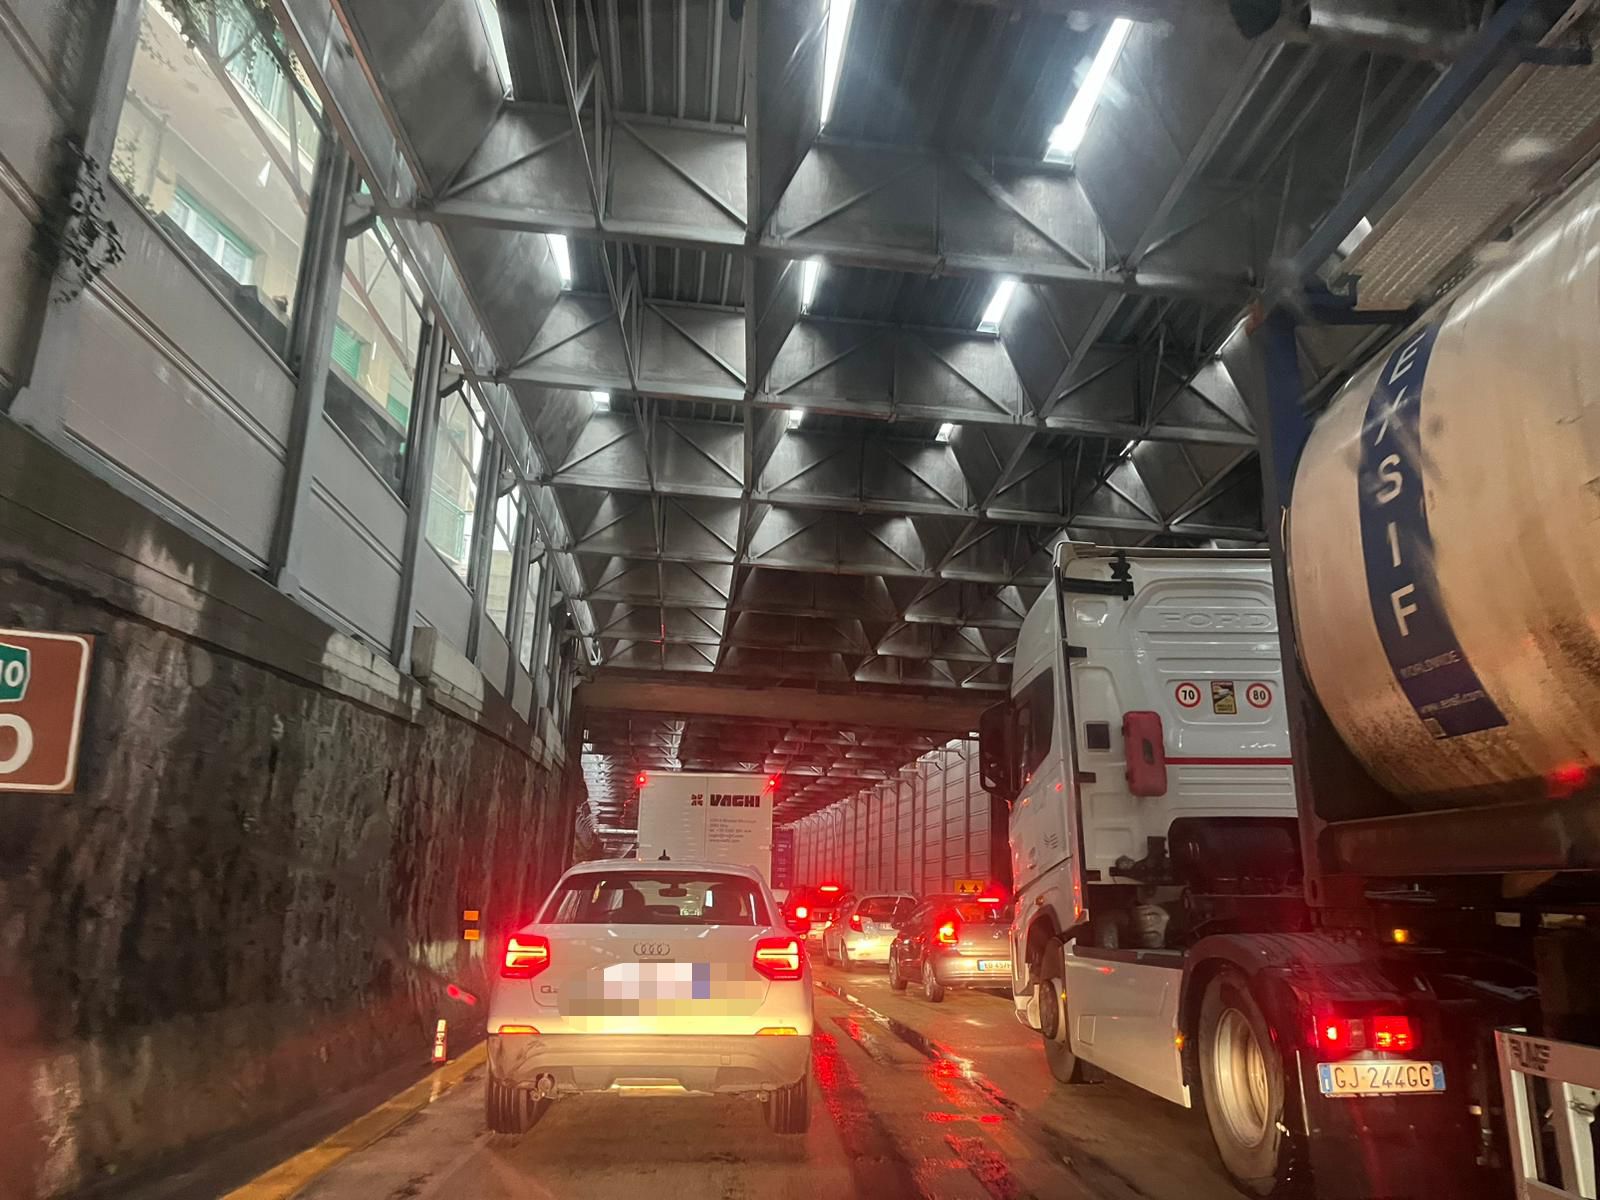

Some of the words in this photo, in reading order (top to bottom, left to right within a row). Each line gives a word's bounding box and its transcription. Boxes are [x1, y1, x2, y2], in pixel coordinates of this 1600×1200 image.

[1157, 612, 1272, 628] FORD
[1181, 689, 1195, 701] 70
[1252, 690, 1266, 701] 80
[710, 794, 761, 808] VAGHI
[1334, 1066, 1359, 1089] GJ
[1367, 1065, 1431, 1088] 244GG
